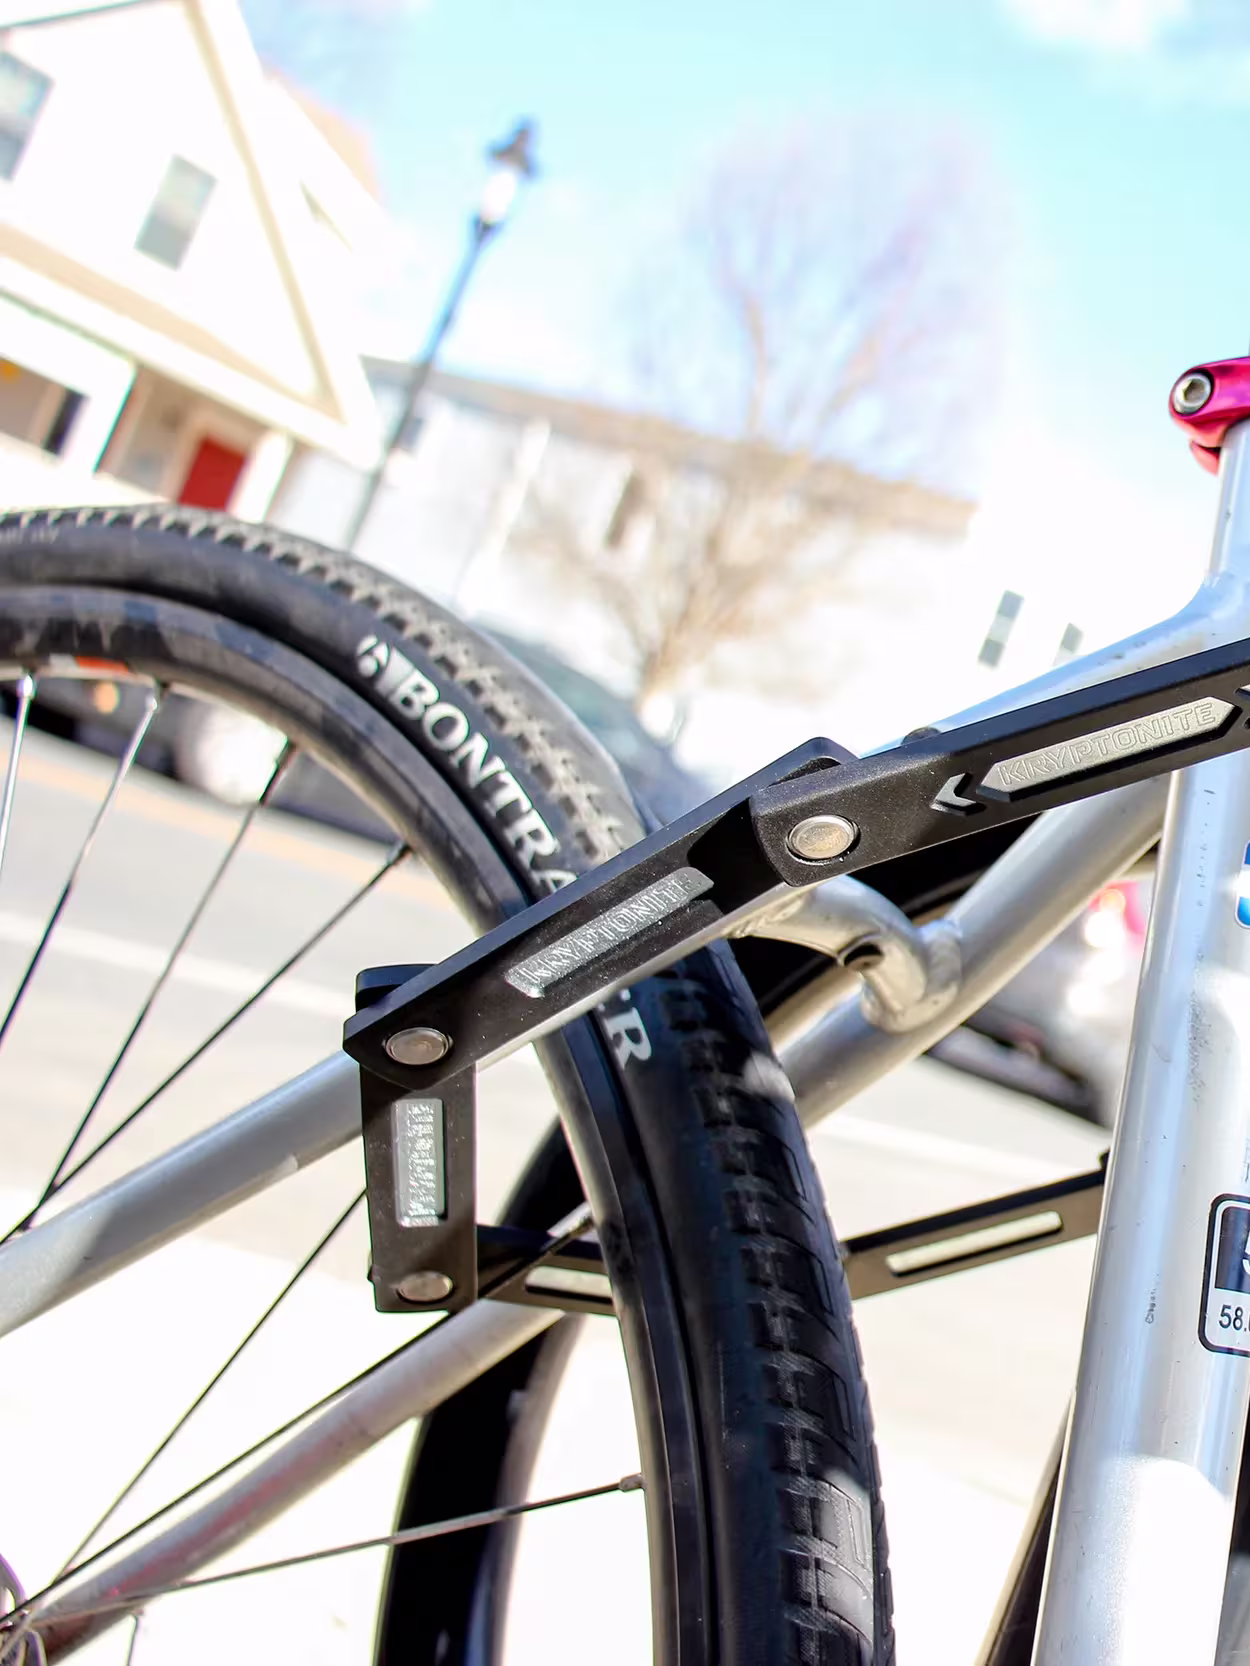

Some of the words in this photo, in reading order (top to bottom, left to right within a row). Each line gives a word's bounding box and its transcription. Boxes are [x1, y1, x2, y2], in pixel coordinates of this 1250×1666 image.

[998, 701, 1217, 786] KRYPTONITE
[376, 646, 653, 1072] BONTRAR
[519, 872, 700, 985] KRYPTONITE
